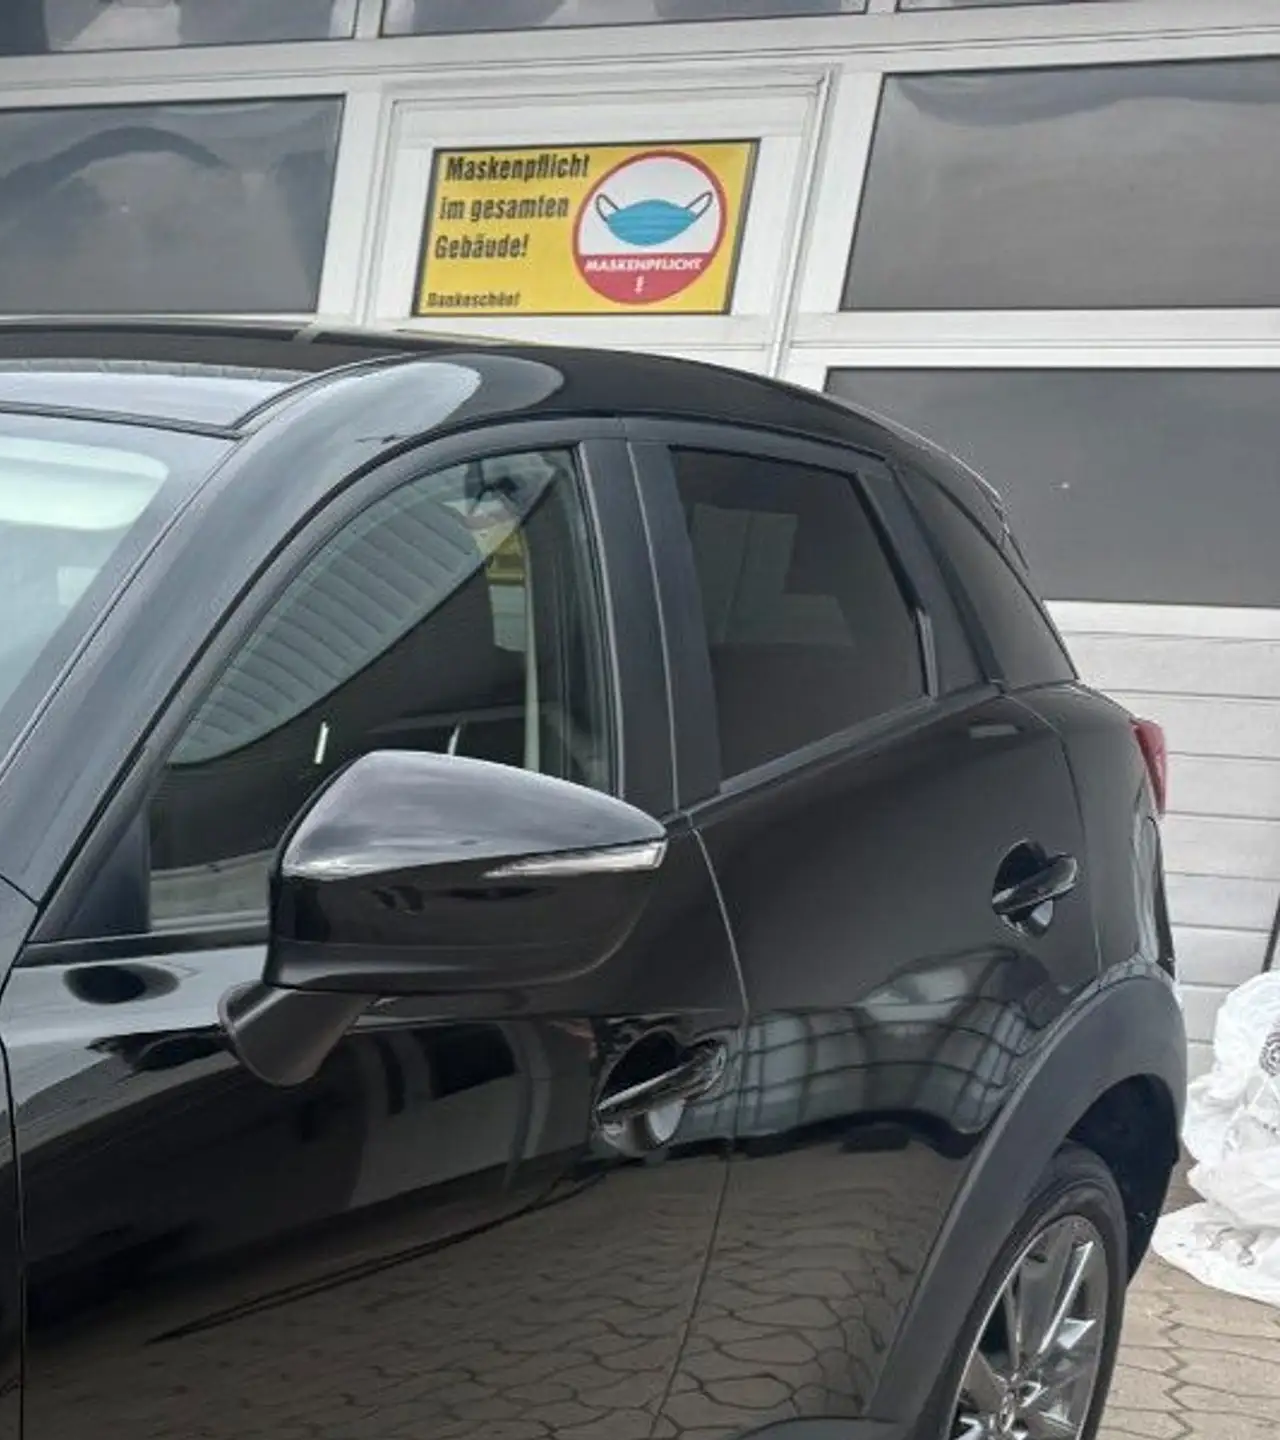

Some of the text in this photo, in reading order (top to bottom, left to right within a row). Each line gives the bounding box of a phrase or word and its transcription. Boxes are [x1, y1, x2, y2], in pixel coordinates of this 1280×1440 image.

[445, 154, 590, 183] Maskenpflicht
[439, 194, 569, 222] im gesamten
[434, 233, 530, 259] Gebäude!
[583, 257, 704, 272] MASKENPFLICHT
